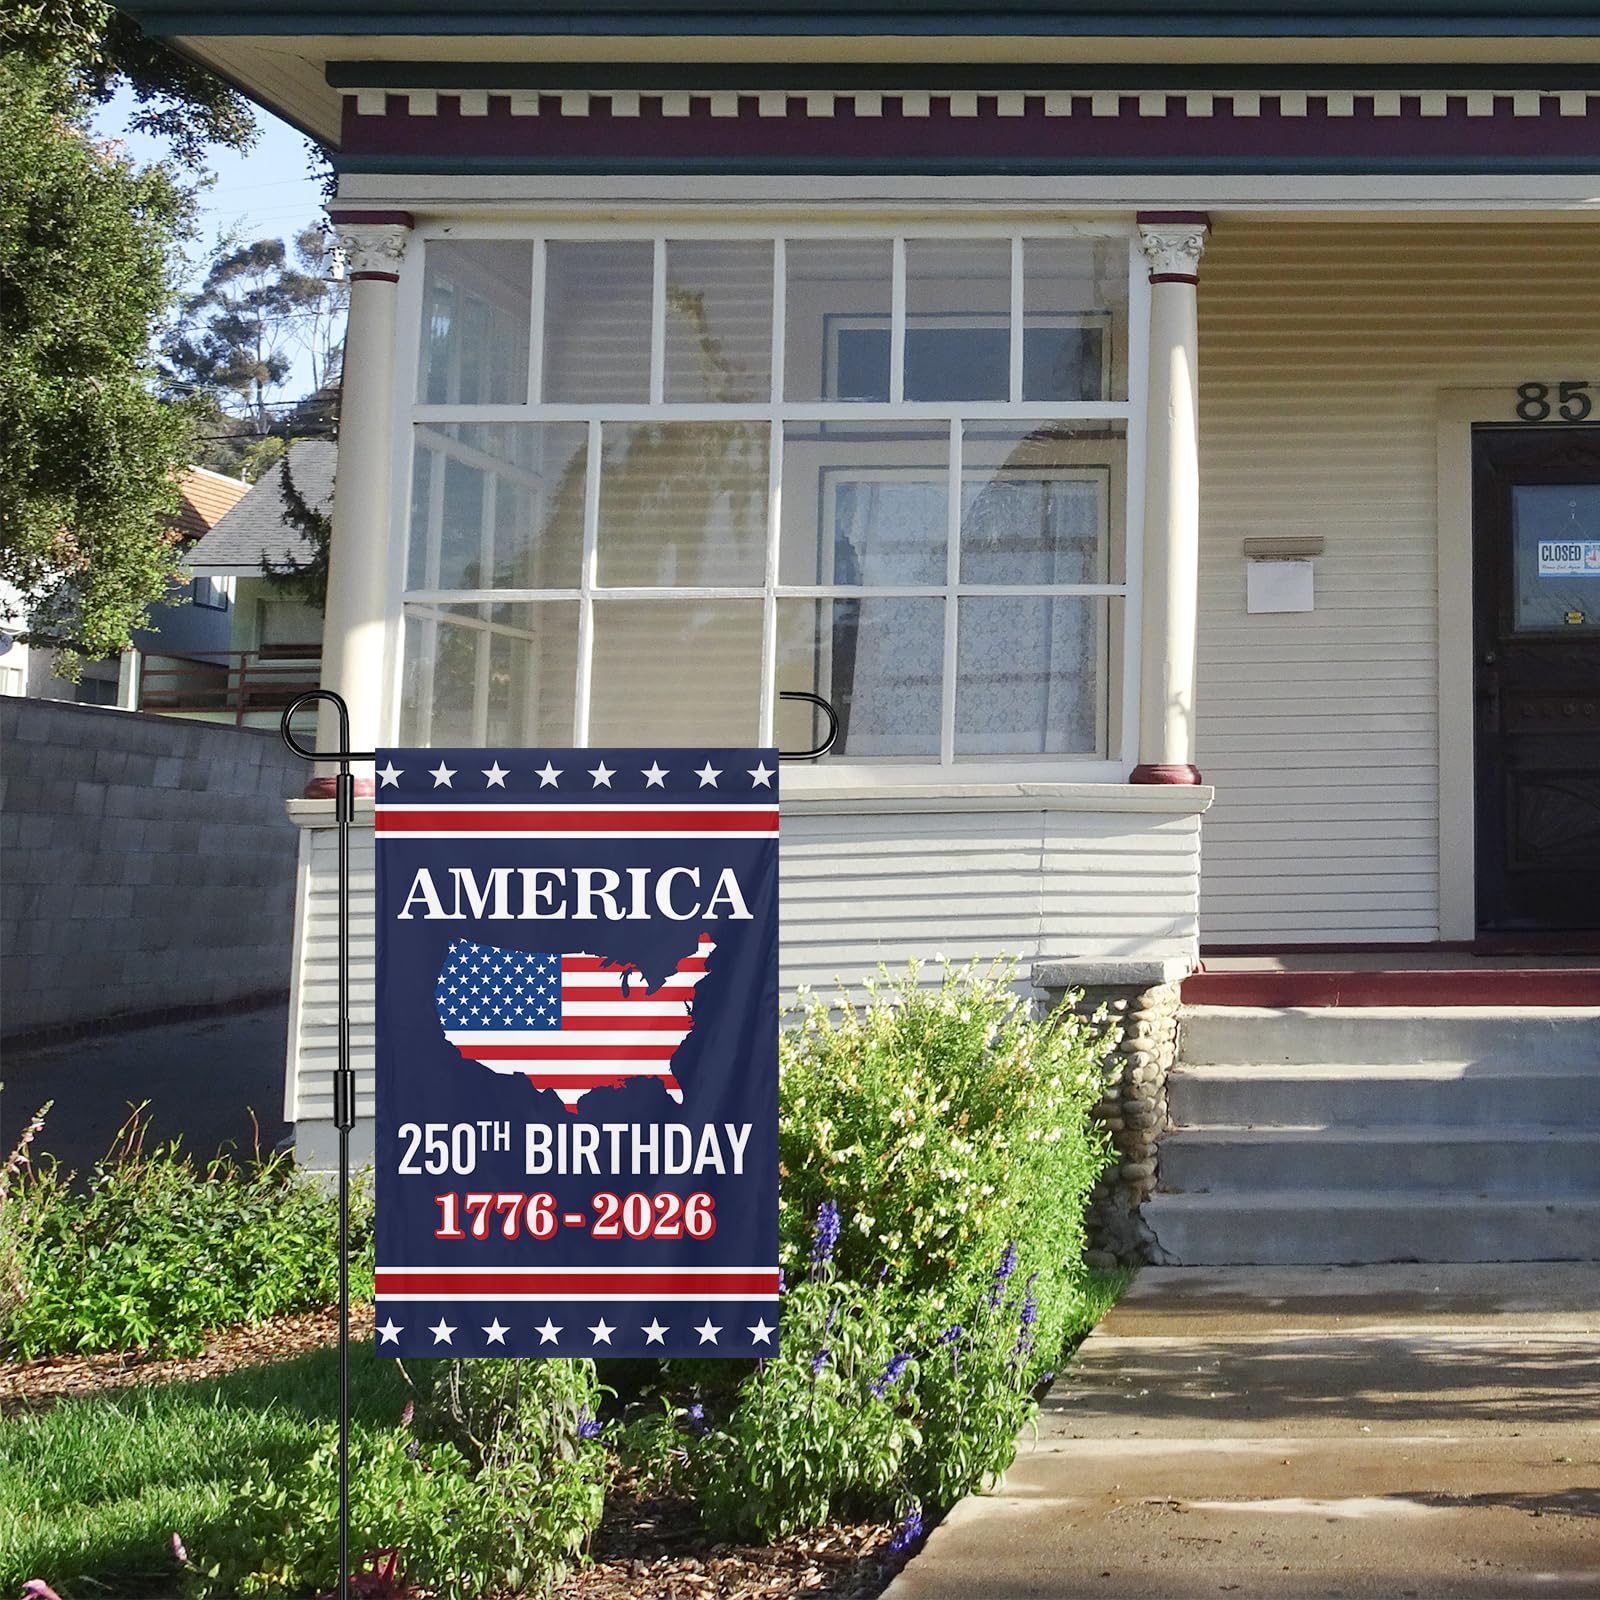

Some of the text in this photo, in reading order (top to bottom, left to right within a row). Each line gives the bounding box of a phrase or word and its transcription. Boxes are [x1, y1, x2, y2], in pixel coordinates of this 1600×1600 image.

[1516, 381, 1592, 422] 85
[1541, 544, 1582, 561] CLOSED
[397, 866, 754, 921] AMERICA
[397, 1120, 753, 1176] 250TH BIRTHDAY
